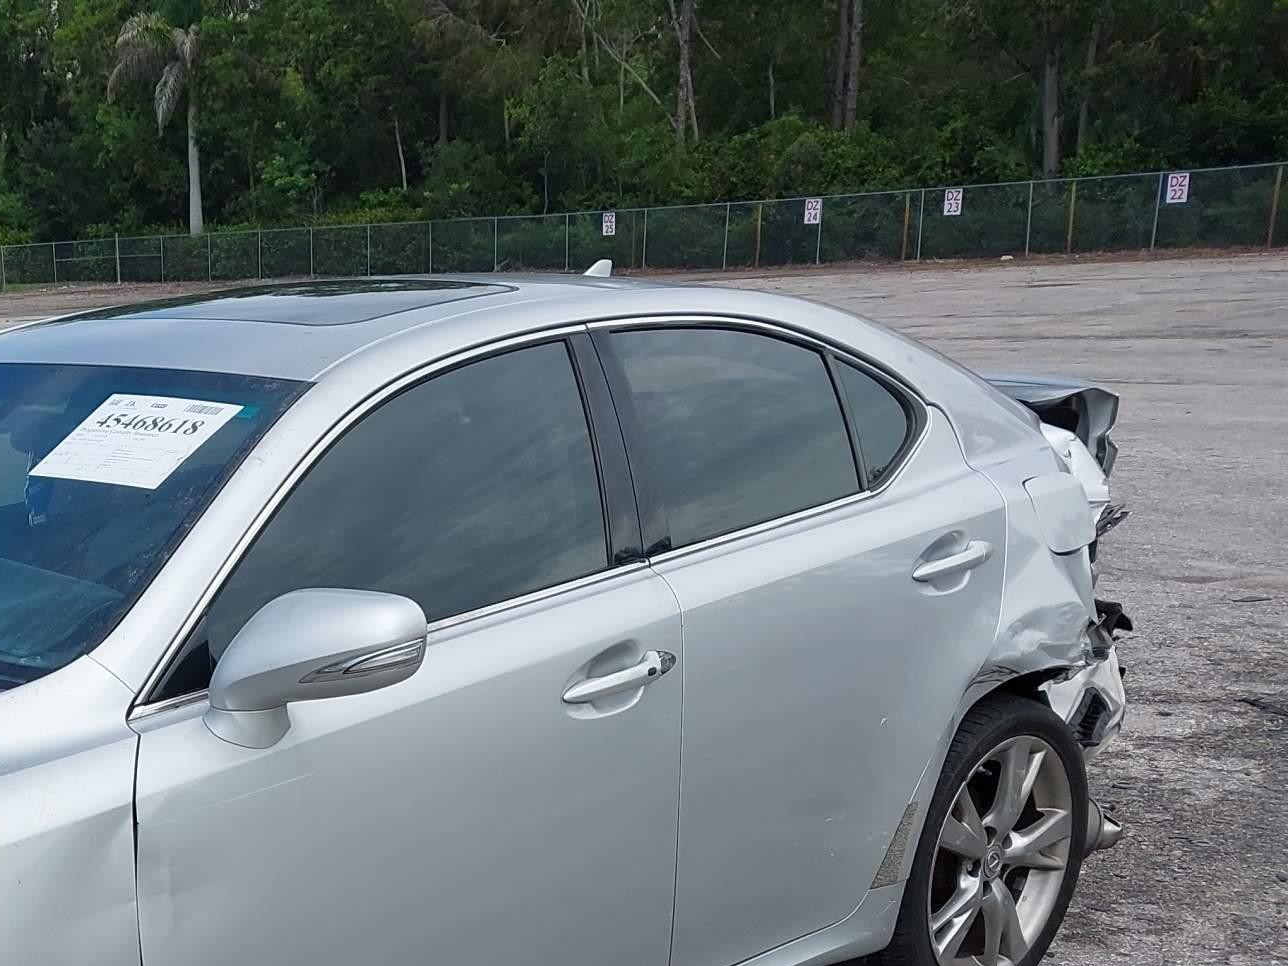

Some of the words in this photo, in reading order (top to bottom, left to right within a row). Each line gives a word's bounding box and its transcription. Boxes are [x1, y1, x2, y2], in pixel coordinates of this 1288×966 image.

[1170, 175, 1187, 188] DZ
[946, 190, 961, 201] DZ
[1170, 188, 1184, 200] 22
[806, 200, 820, 211] DZ
[946, 202, 960, 213] 23
[604, 214, 614, 224] DZ
[807, 211, 818, 222] 24
[604, 224, 614, 234] 25
[96, 413, 205, 436] 45468618
